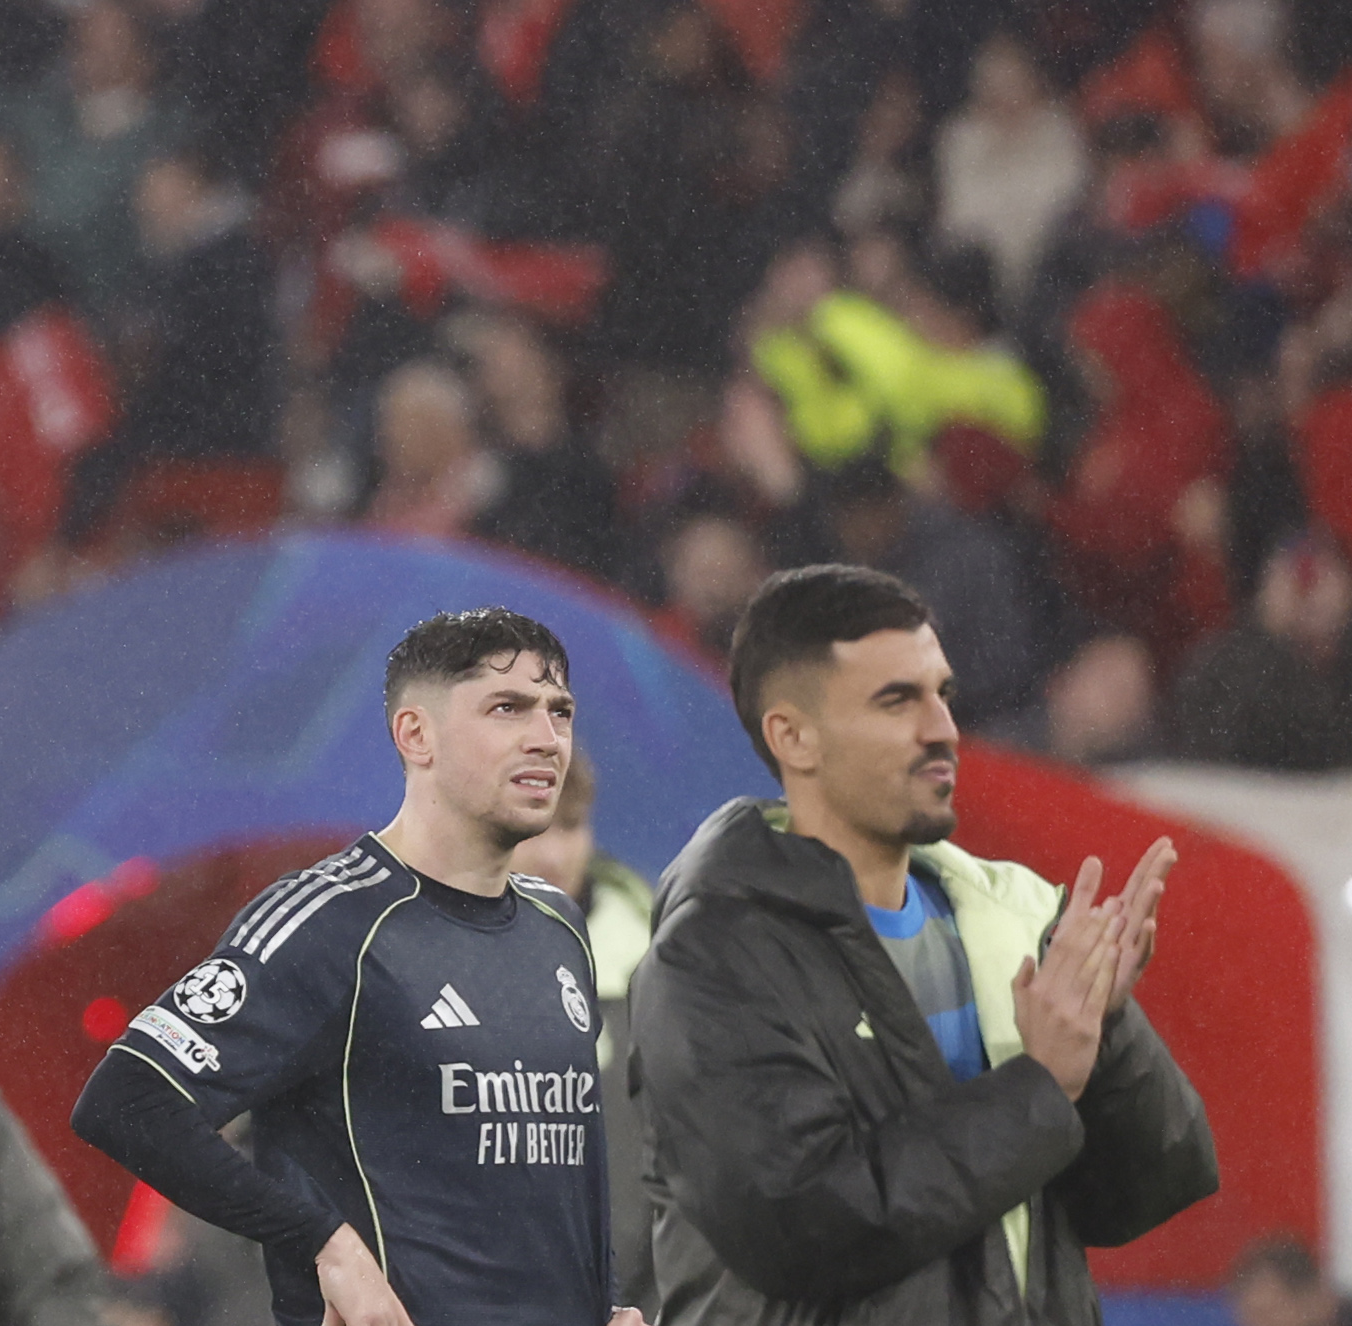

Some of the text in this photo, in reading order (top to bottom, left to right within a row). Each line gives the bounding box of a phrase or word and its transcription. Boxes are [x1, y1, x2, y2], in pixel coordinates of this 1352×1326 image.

[189, 972, 230, 1004] 15
[438, 1059, 601, 1114] Emirate
[477, 1122, 585, 1166] FLY BETTER
